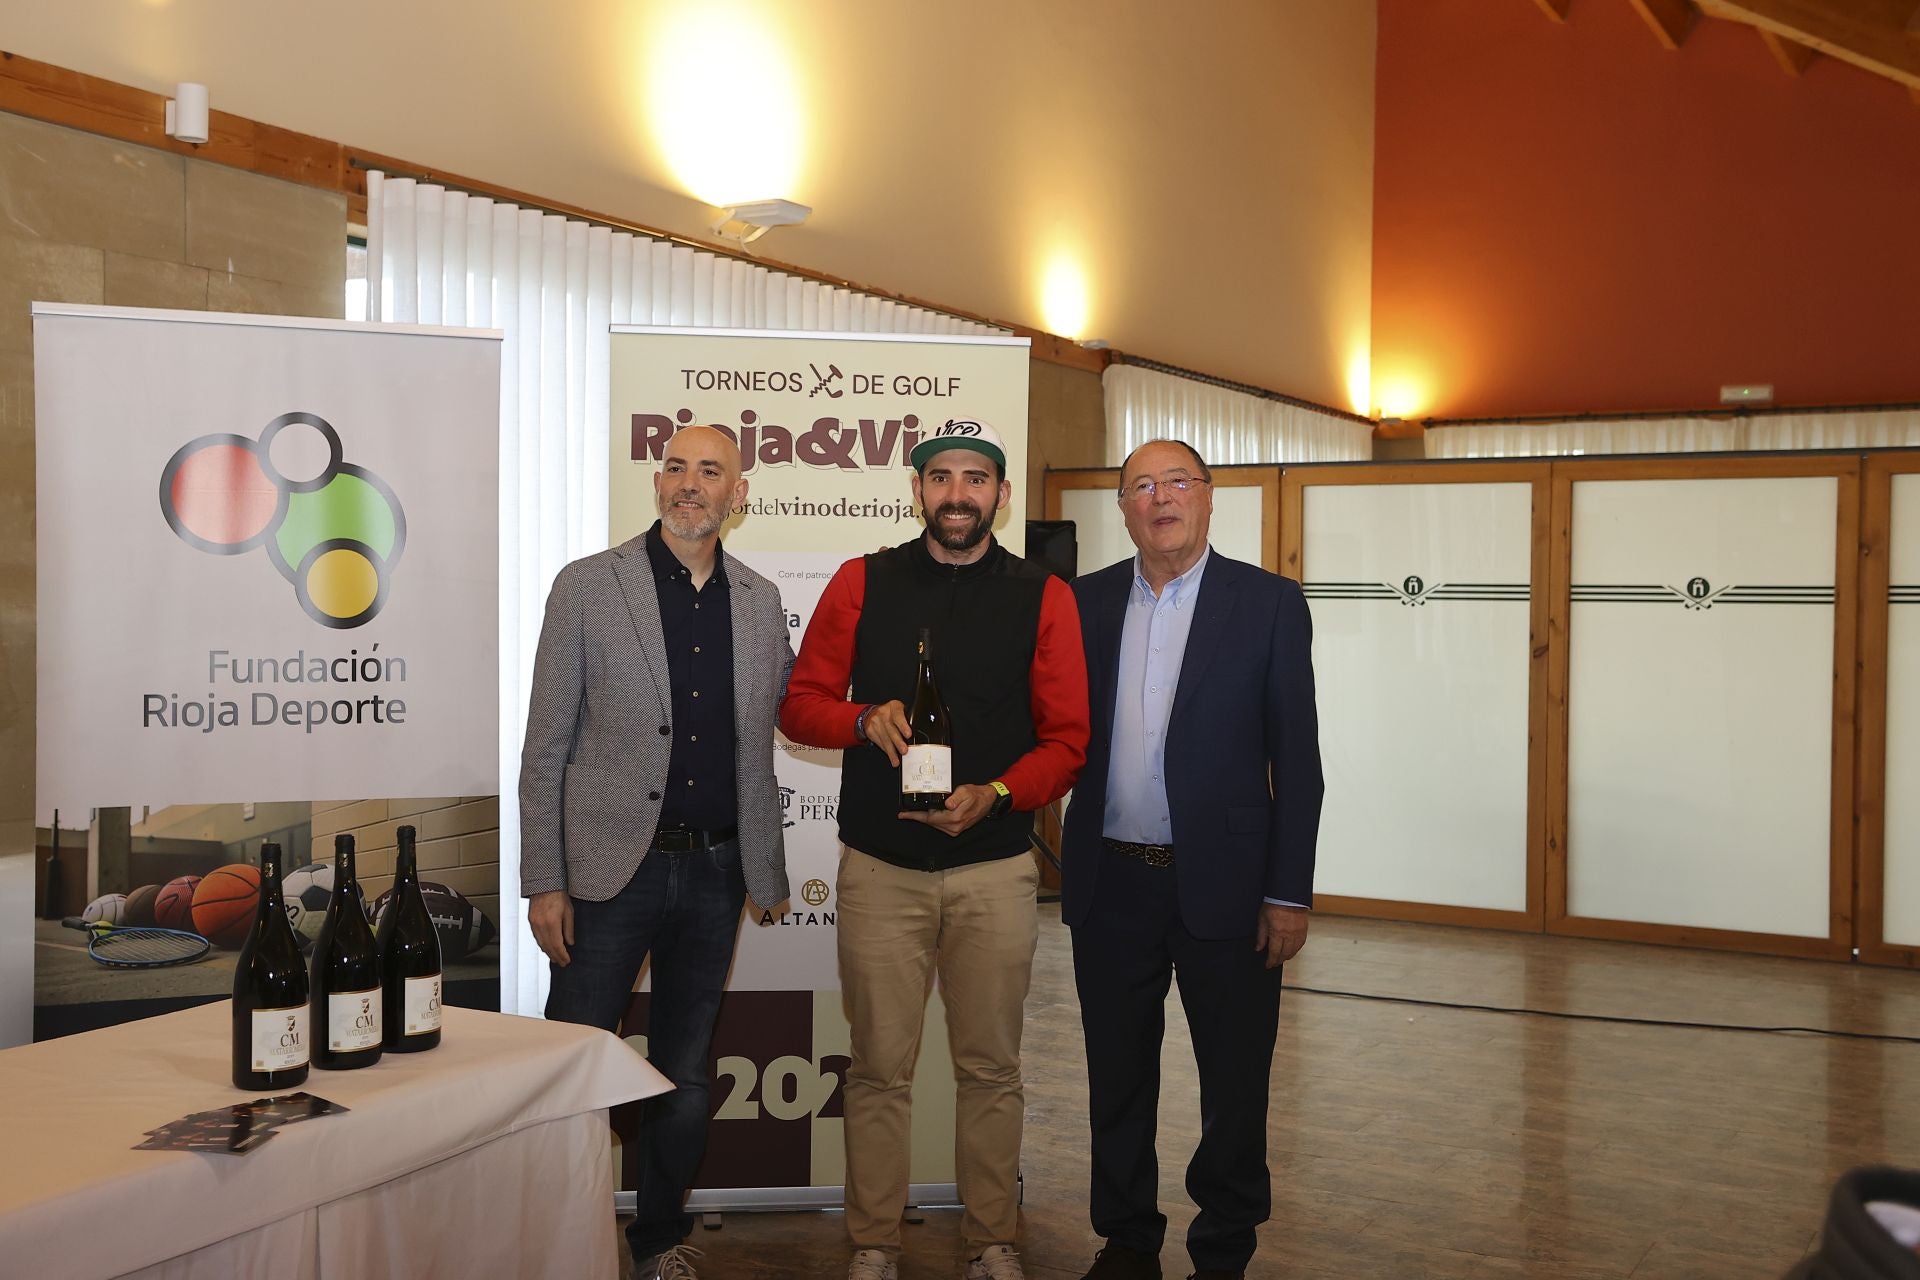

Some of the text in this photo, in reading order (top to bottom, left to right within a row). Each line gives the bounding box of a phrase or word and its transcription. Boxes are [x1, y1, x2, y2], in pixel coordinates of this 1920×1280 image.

[681, 369, 961, 397] TORNEOS DE GOLF
[778, 570, 795, 579] Con
[796, 571, 804, 579] el
[208, 642, 407, 684] Fundación
[143, 692, 407, 733] Rioja Deporte
[800, 804, 838, 820] PER
[759, 909, 835, 926] ALTAN
[355, 1014, 374, 1029] CM
[280, 1031, 300, 1048] CM
[712, 1054, 852, 1121] 202
